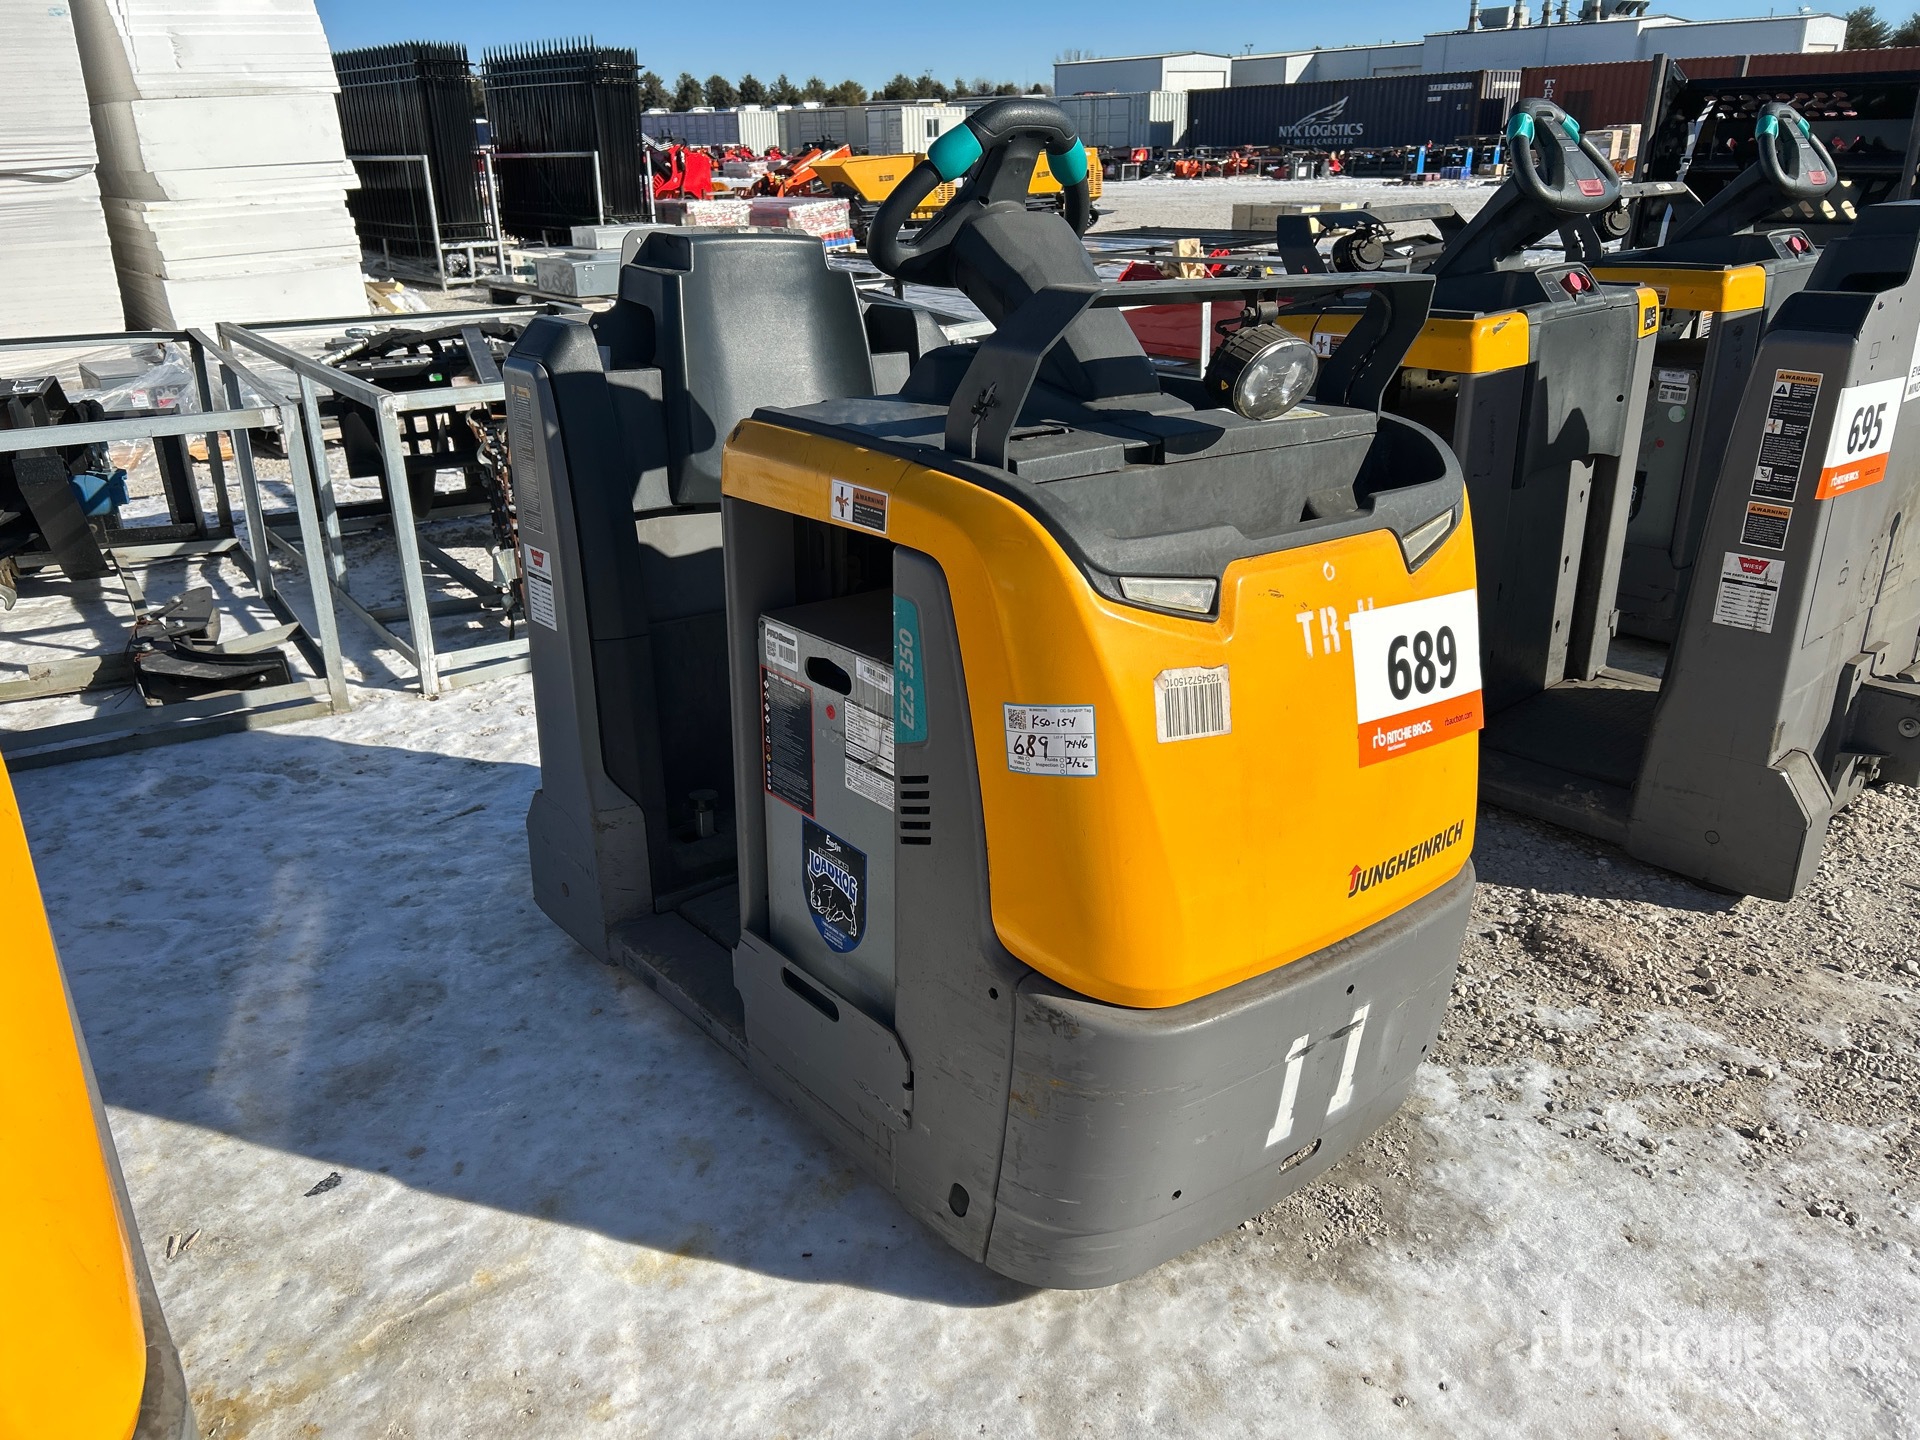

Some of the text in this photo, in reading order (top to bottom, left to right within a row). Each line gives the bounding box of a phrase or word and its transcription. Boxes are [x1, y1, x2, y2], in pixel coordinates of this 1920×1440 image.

[1278, 123, 1364, 137] NYK LOGISTICS
[1785, 375, 1818, 383] WARNING
[1847, 402, 1888, 455] 695
[1757, 507, 1788, 516] WARNING
[1743, 562, 1763, 571] WIESE
[1387, 625, 1458, 701] 689
[899, 627, 915, 731] EZS 350
[1444, 711, 1473, 726] rbauction.com
[1386, 725, 1412, 745] RITCHIE
[1013, 735, 1048, 758] 689
[1347, 819, 1465, 899] JUNGHEINRICH
[808, 849, 858, 906] LOADHOG
